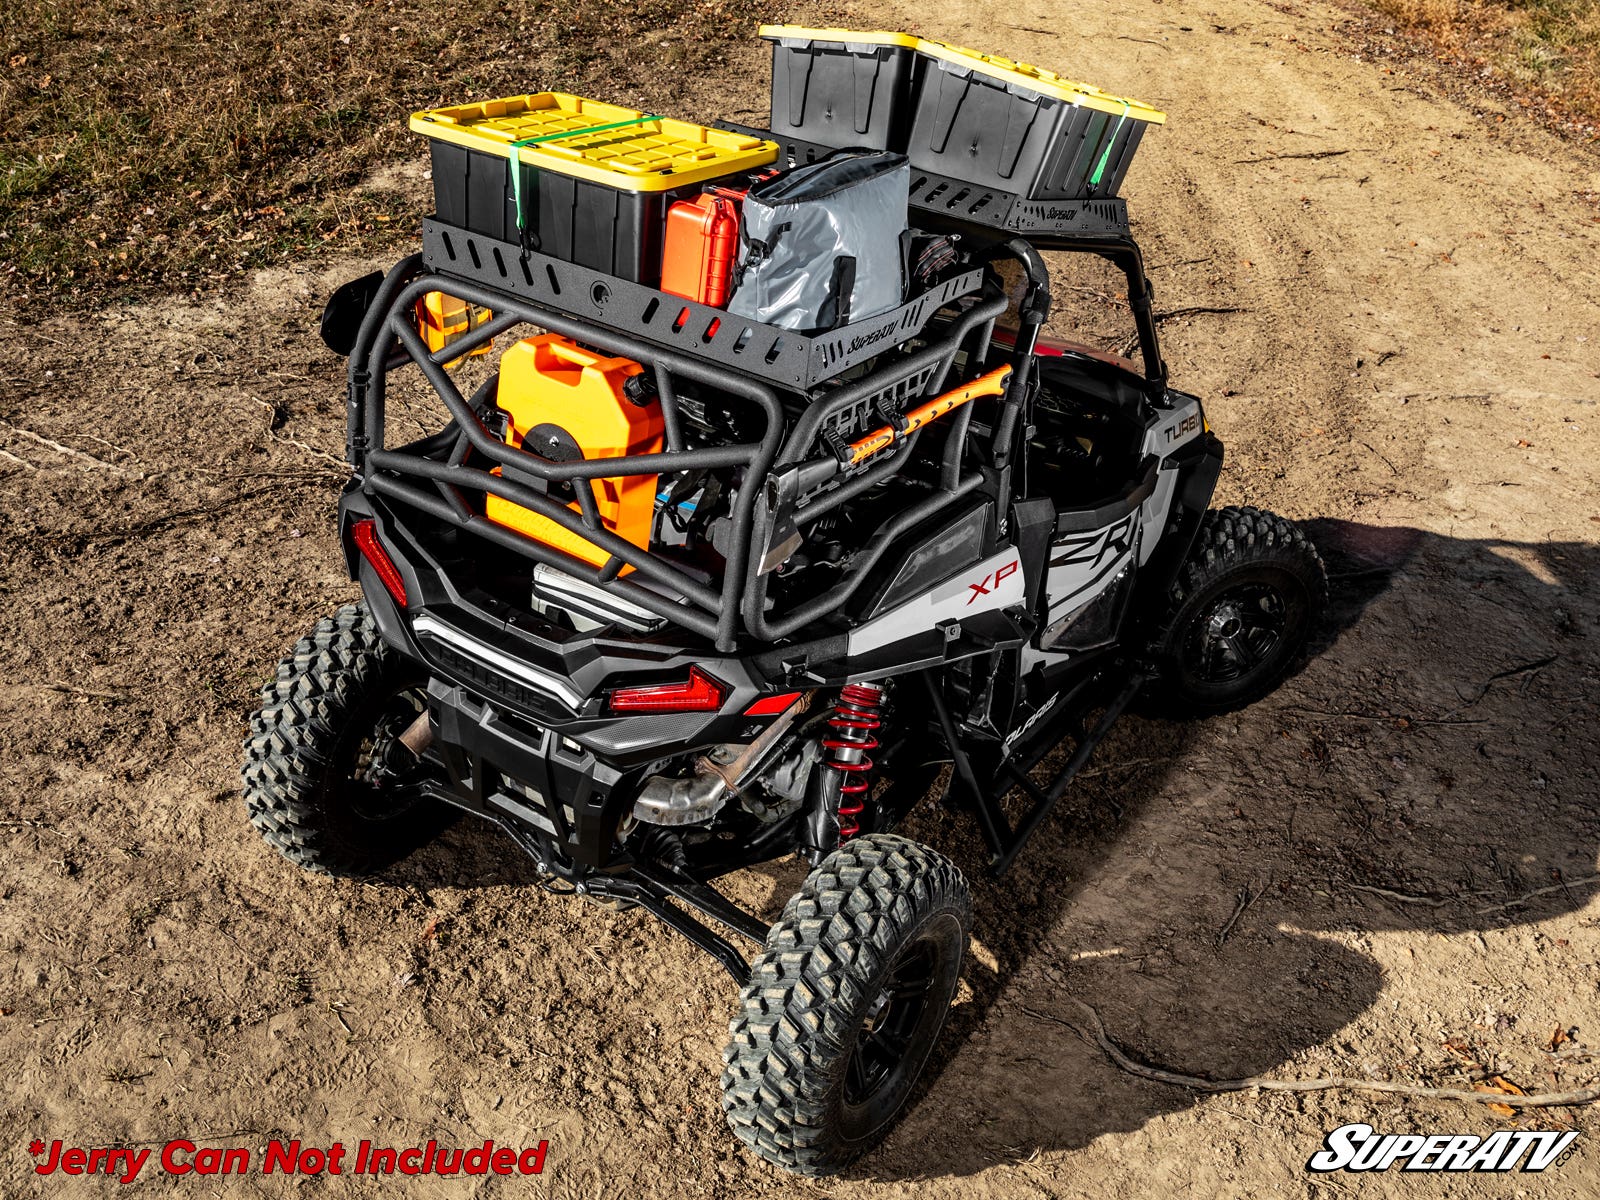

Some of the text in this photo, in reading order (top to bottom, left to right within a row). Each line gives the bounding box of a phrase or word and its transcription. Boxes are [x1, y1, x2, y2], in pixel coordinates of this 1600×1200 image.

[847, 320, 899, 354] SUPERATV
[967, 560, 1018, 605] XP
[1005, 690, 1060, 746] OLARIS
